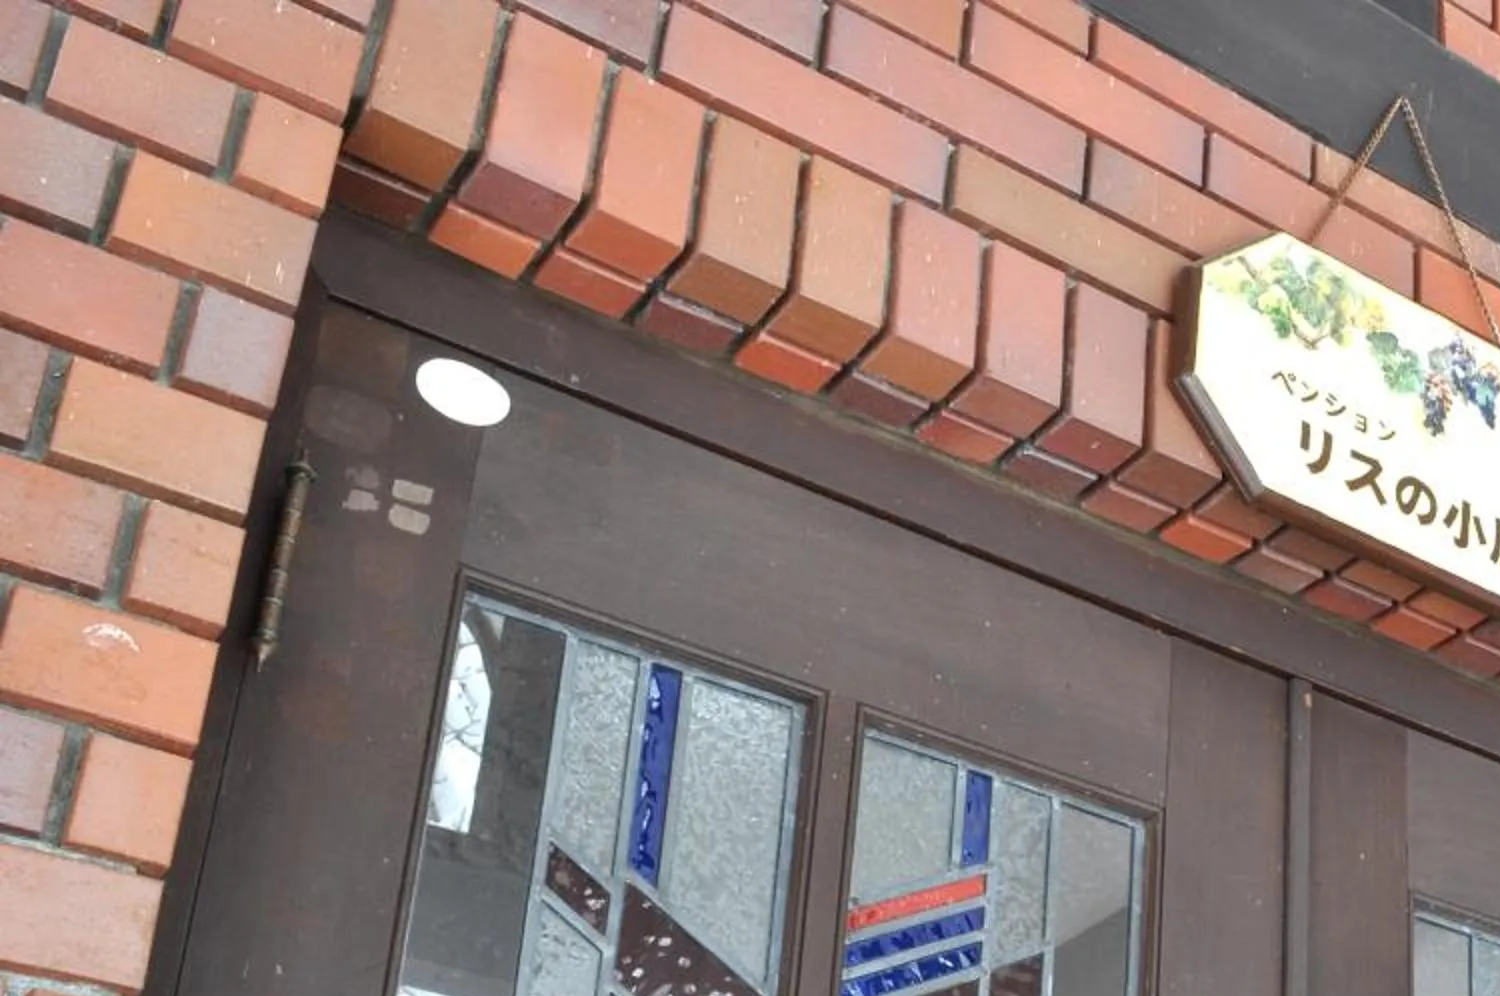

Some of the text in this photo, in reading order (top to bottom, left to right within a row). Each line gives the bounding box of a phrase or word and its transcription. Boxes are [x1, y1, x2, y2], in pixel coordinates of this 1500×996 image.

[1272, 370, 1396, 441] ペンション
